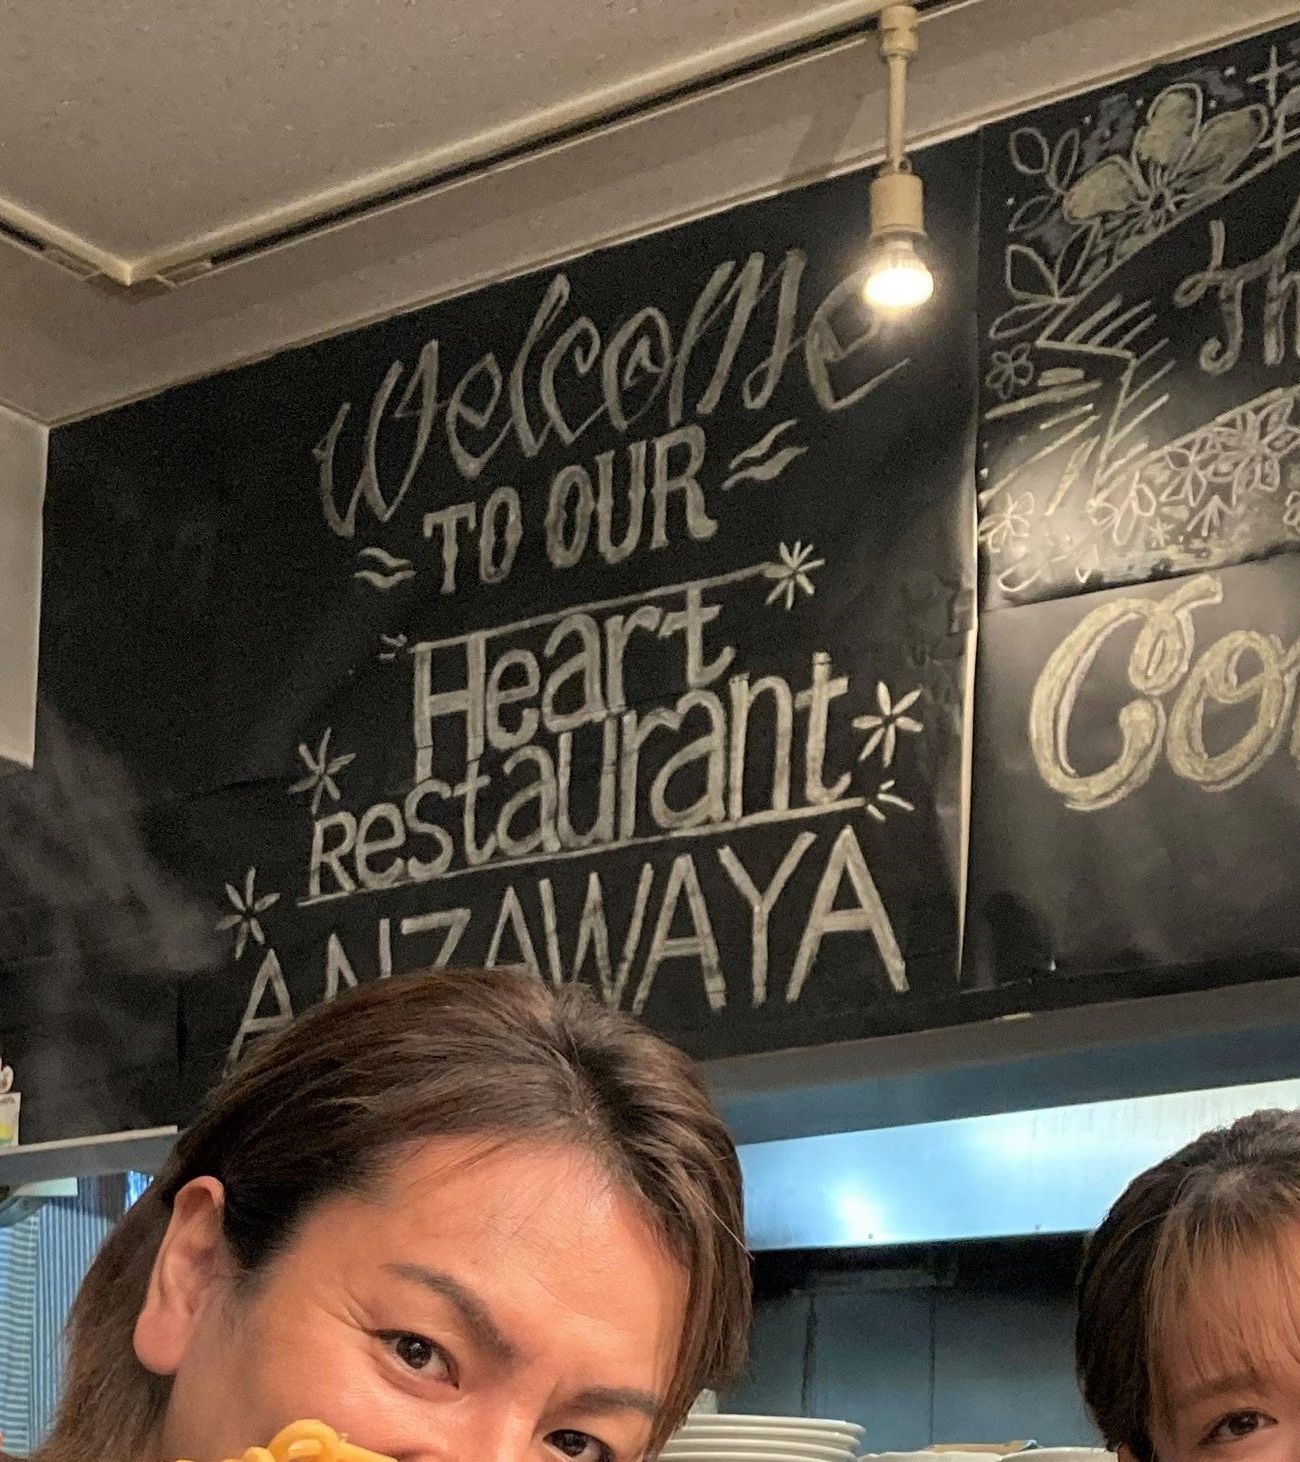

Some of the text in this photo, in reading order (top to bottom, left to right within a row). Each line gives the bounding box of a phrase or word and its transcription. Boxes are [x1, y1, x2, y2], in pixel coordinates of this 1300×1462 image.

[313, 248, 910, 538] Welcome
[423, 425, 718, 594] TO OUR
[308, 651, 853, 899] Restaurant
[412, 588, 736, 783] Heart
